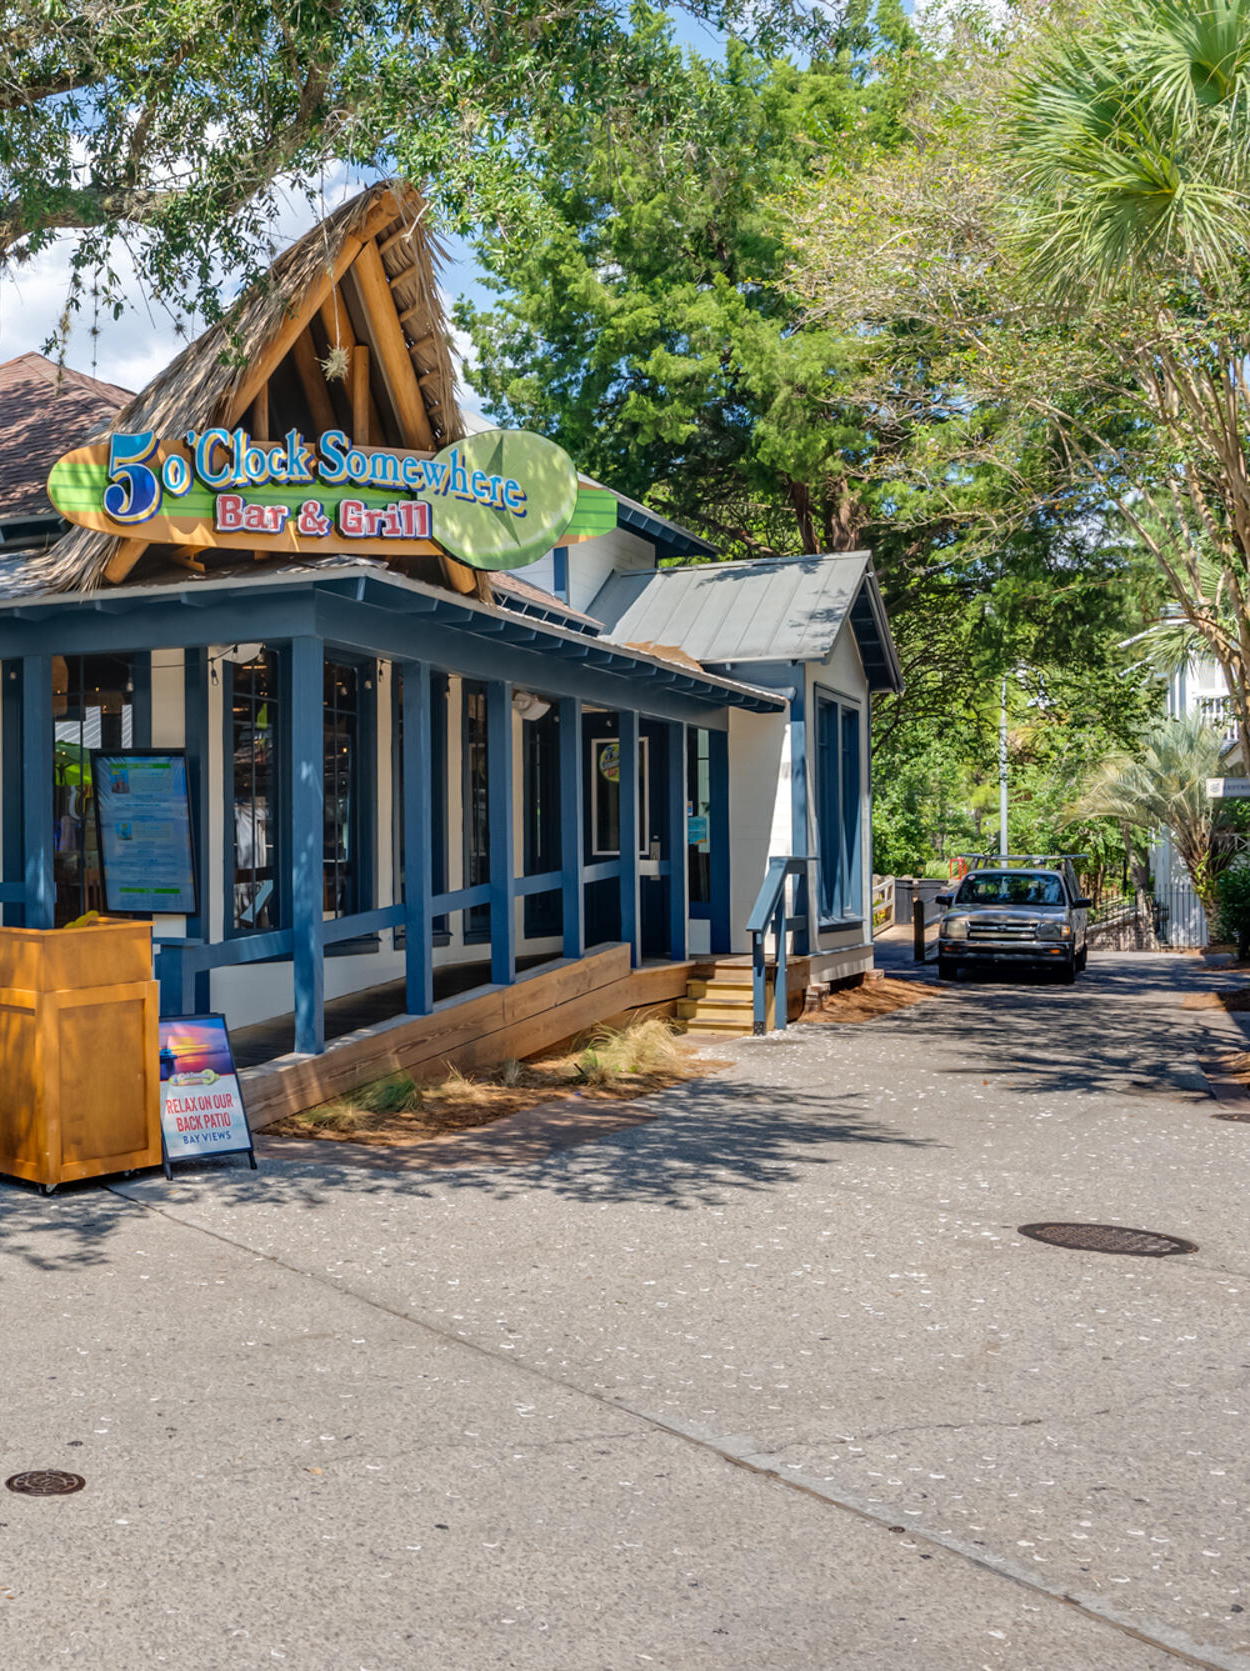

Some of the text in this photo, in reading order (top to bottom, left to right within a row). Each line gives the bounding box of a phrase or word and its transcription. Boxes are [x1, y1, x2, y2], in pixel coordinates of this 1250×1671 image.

[104, 428, 524, 522] 5 o'Clock Somewhere
[217, 494, 431, 538] Bar & Grill
[166, 1094, 233, 1114] RELAX ON OUR
[176, 1113, 231, 1132] BACK PATIO
[184, 1131, 231, 1144] BAY VIEWS
